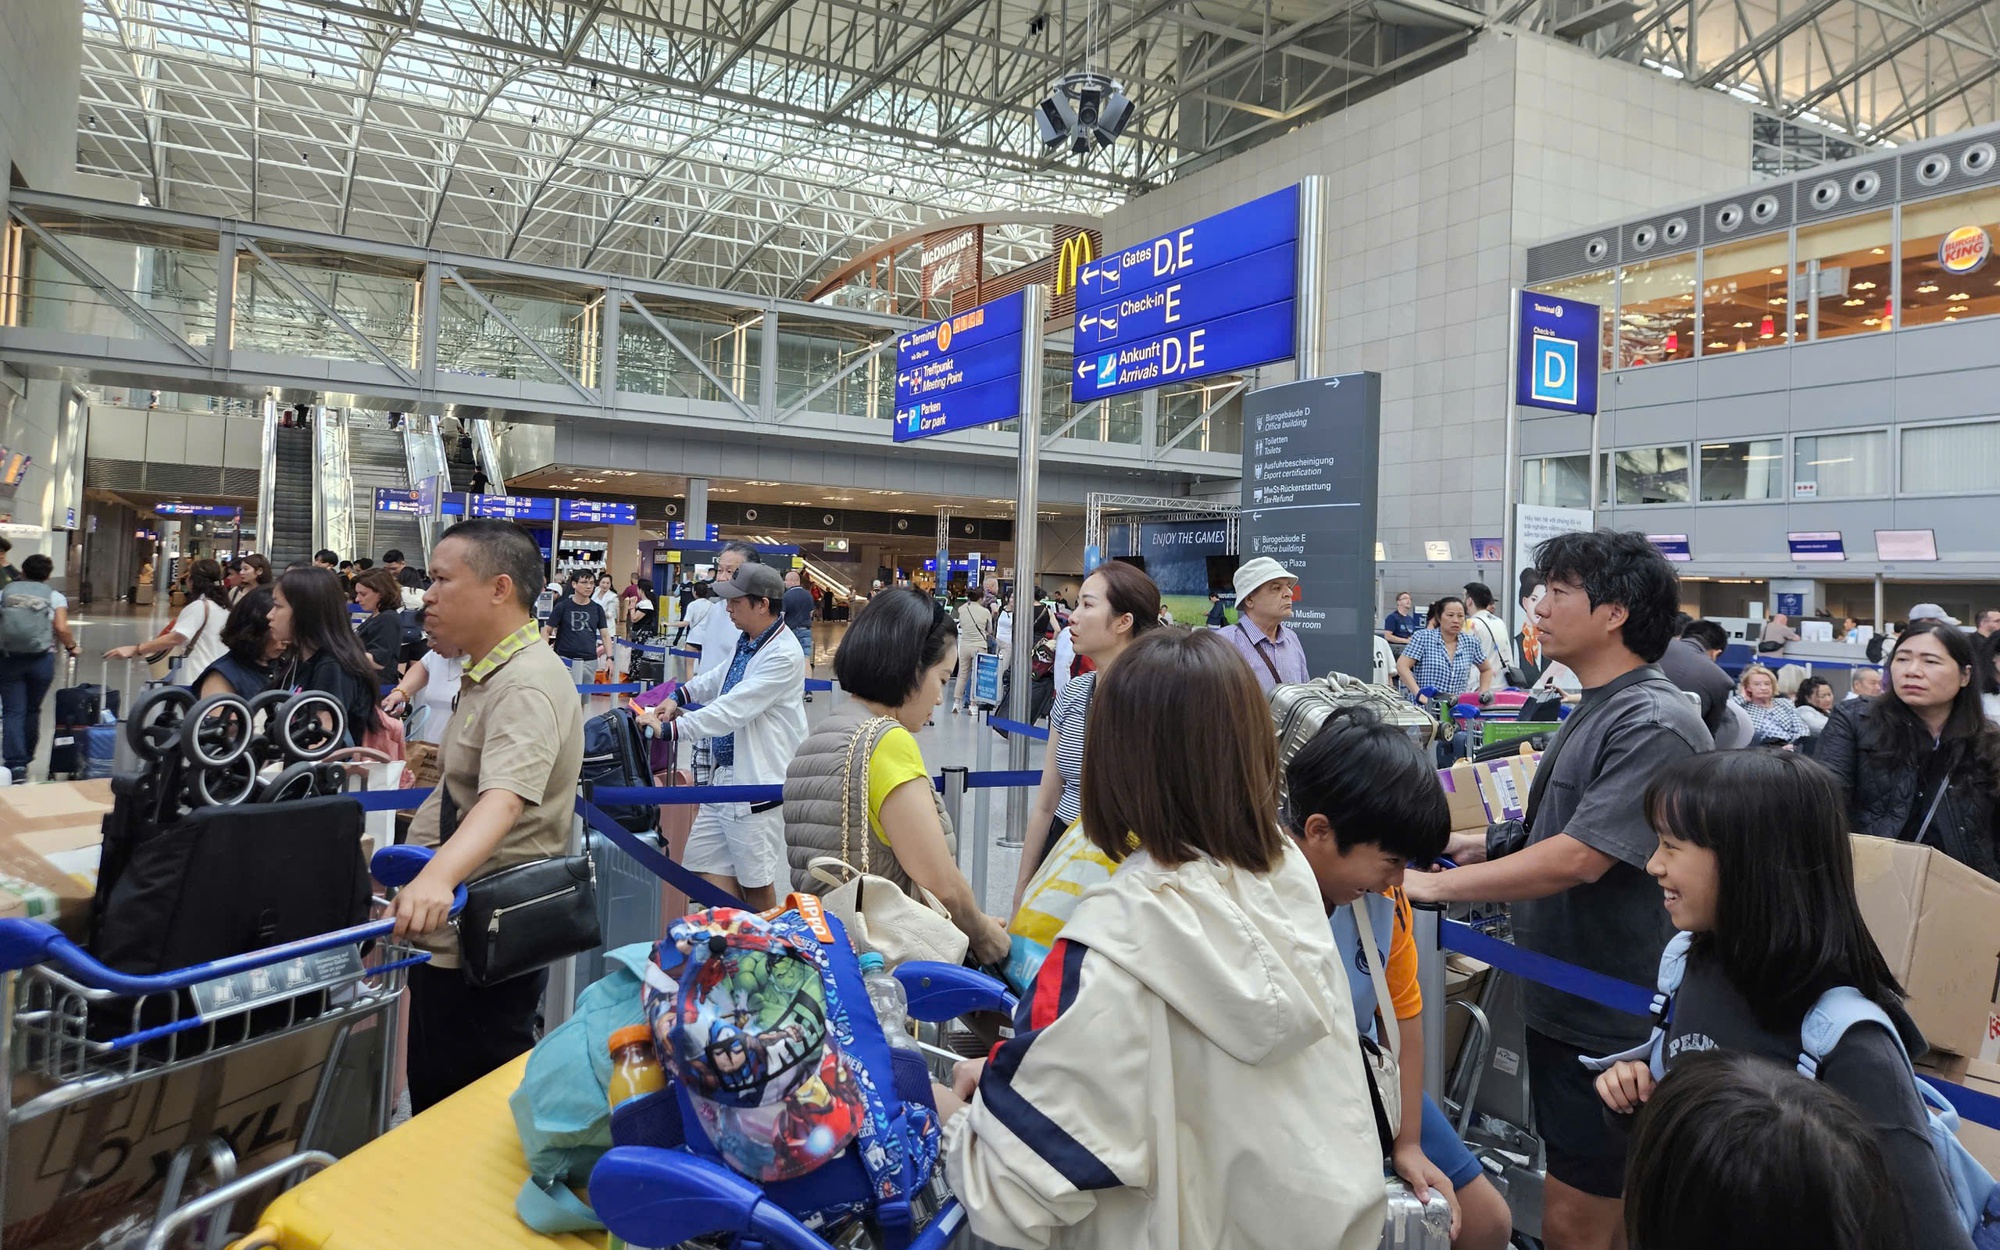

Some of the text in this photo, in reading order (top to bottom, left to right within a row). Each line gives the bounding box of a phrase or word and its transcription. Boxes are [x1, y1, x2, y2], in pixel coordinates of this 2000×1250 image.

[921, 232, 973, 267] McDonald's
[1945, 233, 1984, 252] BURGER
[1122, 227, 1195, 278] Gates D,E
[1945, 242, 1984, 263] KING
[1120, 283, 1182, 324] Check-in E
[1534, 303, 1555, 315] Terminal
[911, 326, 937, 347] Terminal
[1533, 325, 1556, 337] Check-in
[1118, 328, 1206, 376] Ankunft D,E
[923, 358, 954, 377] Treffpunkt
[1118, 362, 1159, 385] Arrivals
[1544, 350, 1567, 388] D
[922, 371, 963, 392] Meeting Point
[920, 402, 941, 416] Parken
[1304, 407, 1311, 416] D
[920, 413, 947, 430] Car park
[1264, 418, 1308, 432] Office building
[1264, 436, 1289, 446] Toiletten
[1264, 446, 1282, 456] Toilets
[1263, 456, 1335, 471] Ausfuhrbescheinigung
[1263, 467, 1322, 481] Export certification
[1152, 530, 1226, 547] ENJOY THE GAMES
[1301, 533, 1306, 542] E
[1261, 544, 1304, 554] Office building
[1289, 559, 1307, 568] Plaza
[1296, 609, 1326, 619] Muslime
[1302, 620, 1322, 629] room
[800, 893, 828, 936] HIPPO
[1668, 1033, 1721, 1058] PEAN
